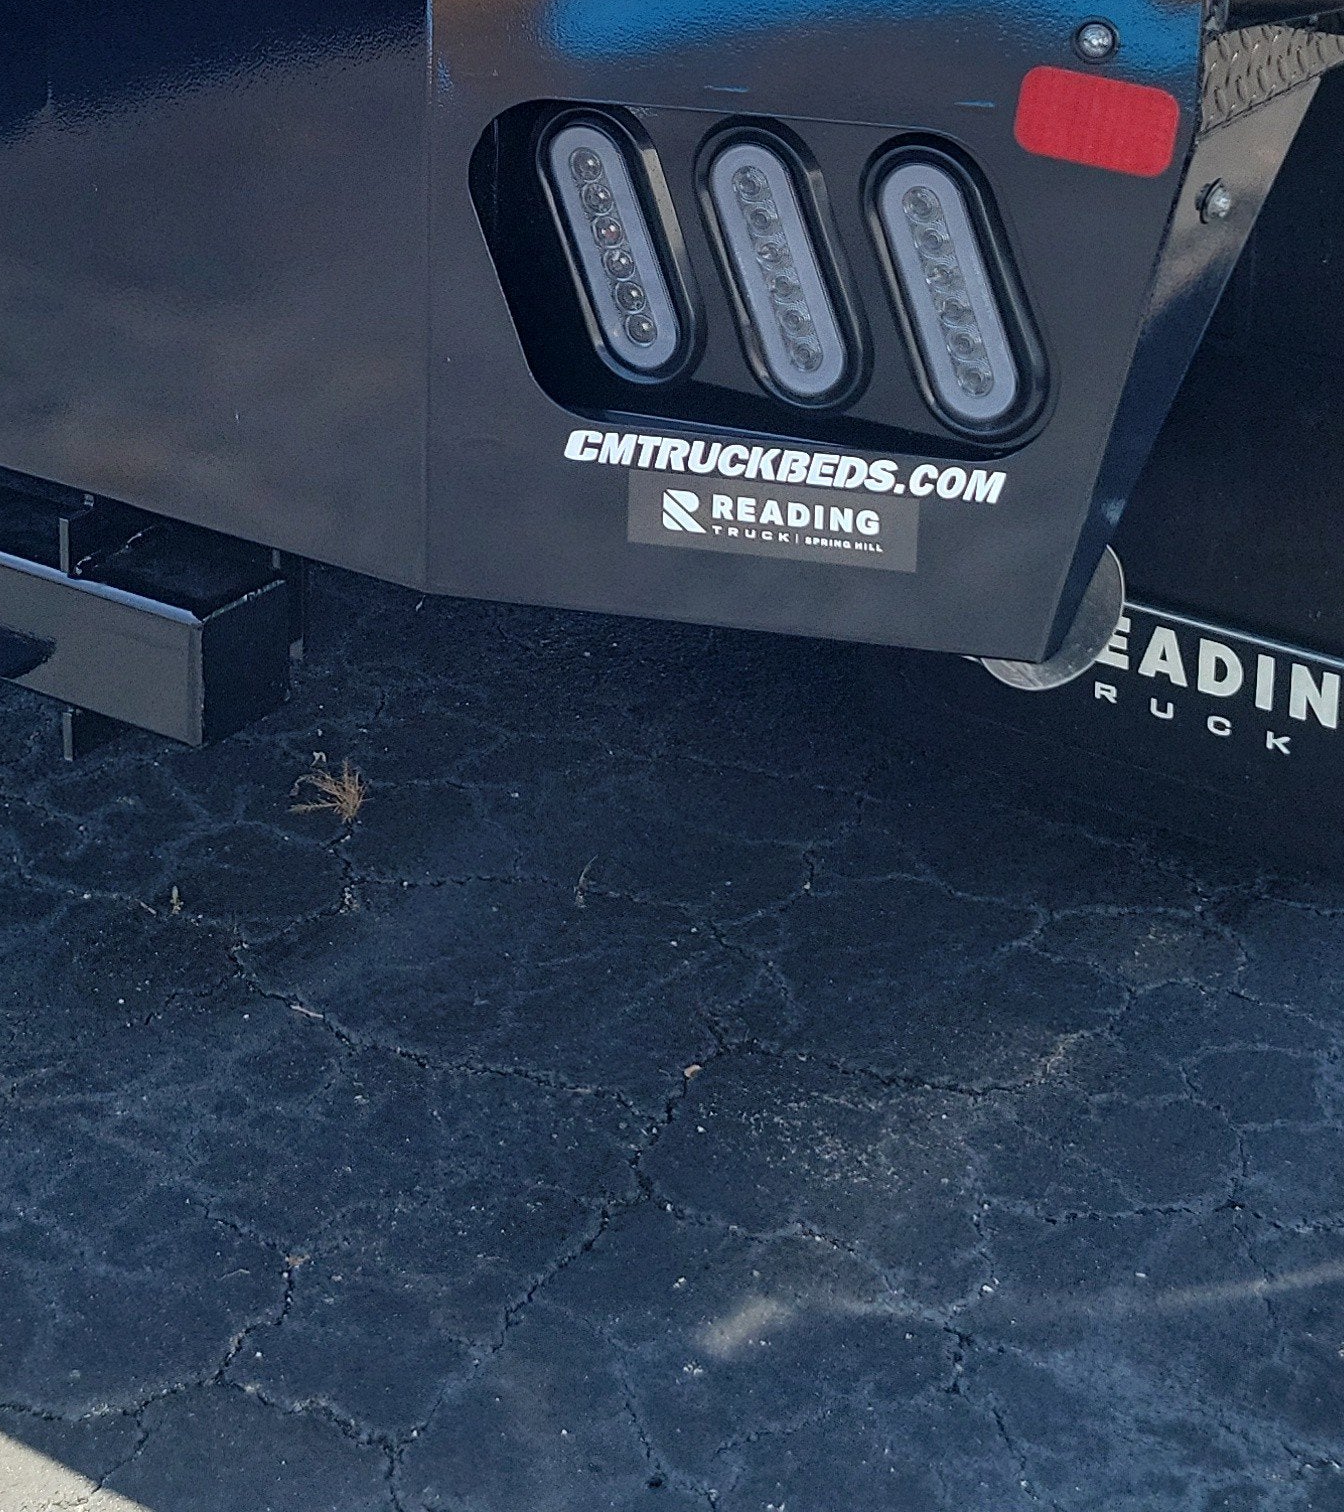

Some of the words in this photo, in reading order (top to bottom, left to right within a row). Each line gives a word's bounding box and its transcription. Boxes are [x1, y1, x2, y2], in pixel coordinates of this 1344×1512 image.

[564, 429, 1007, 504] CMTRUCKBEDS.COM
[712, 494, 880, 536] READING
[712, 525, 791, 543] TRUCK
[804, 536, 852, 549] SPRING
[855, 541, 884, 553] HILL
[1094, 682, 1291, 755] RUCK
